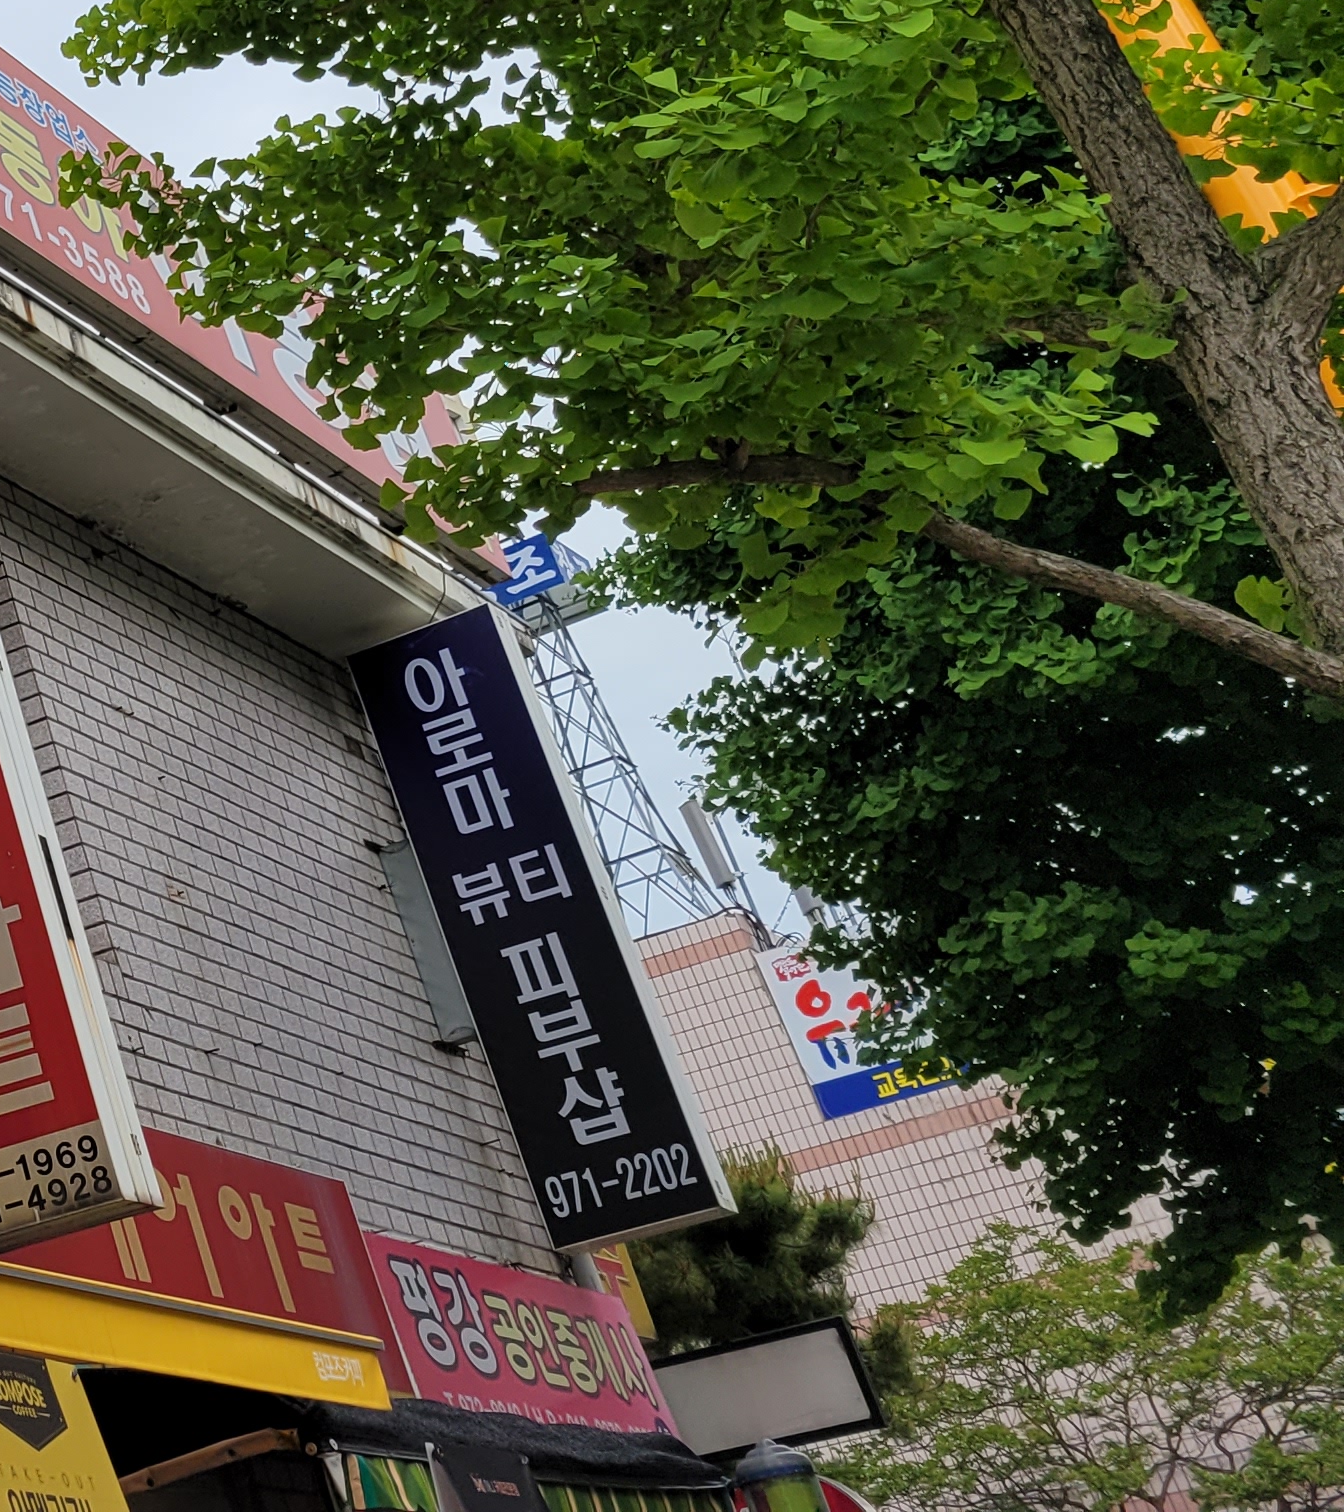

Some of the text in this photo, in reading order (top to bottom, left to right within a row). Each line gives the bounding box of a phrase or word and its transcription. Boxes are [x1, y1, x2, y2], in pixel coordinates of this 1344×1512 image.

[403, 647, 515, 836] 아로마
[451, 843, 574, 927] 뷰티
[500, 931, 632, 1147] 피부샵
[544, 1143, 698, 1220] 971-2202
[389, 1259, 498, 1375] 평강
[483, 1293, 659, 1409] 공인중개사
[13, 1404, 38, 1419] COFFEE
